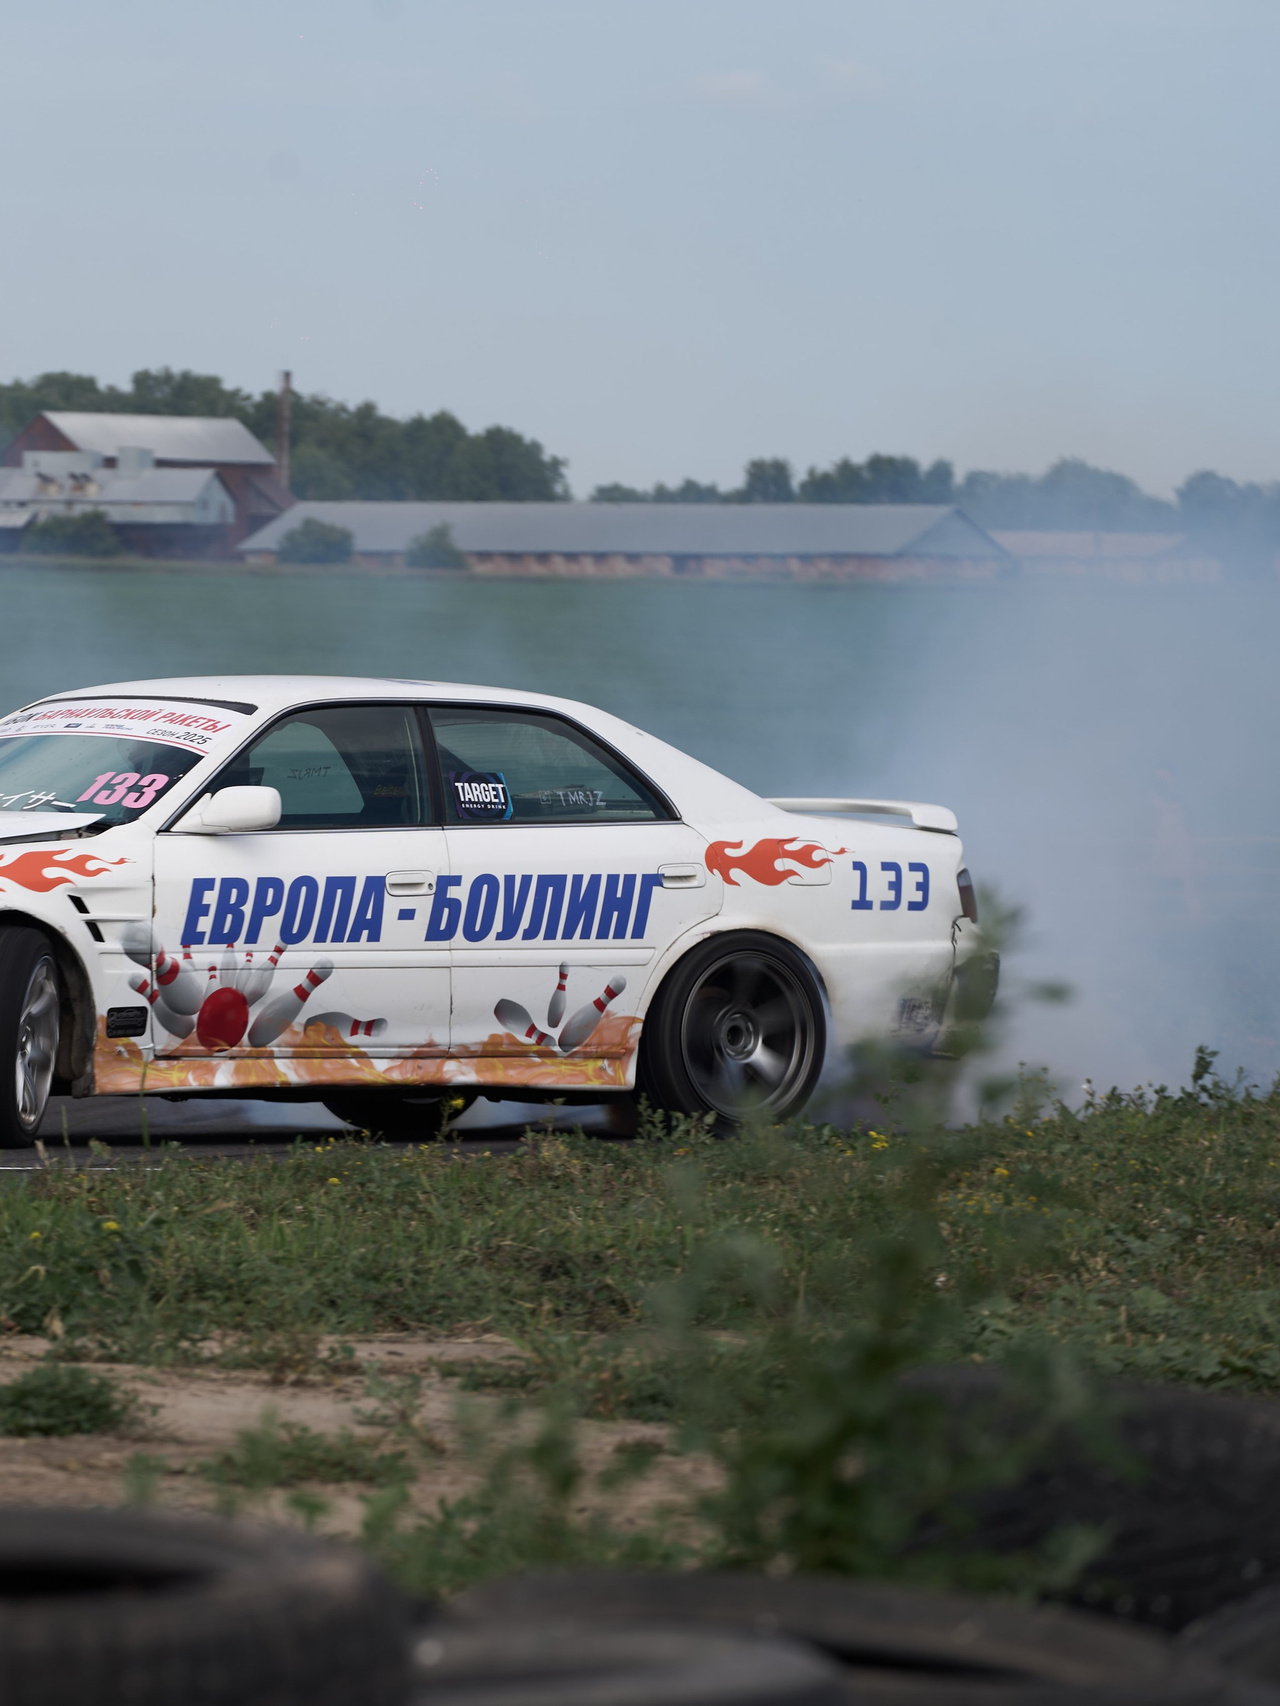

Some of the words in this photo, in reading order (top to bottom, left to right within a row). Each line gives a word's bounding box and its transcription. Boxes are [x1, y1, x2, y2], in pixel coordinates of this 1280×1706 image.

[146, 728, 179, 738] СЕЗОН
[175, 731, 213, 745] 2025
[160, 712, 232, 733] РАКЕТЫ
[76, 771, 170, 809] 133
[454, 782, 507, 803] TARGET
[851, 861, 930, 911] 133
[180, 875, 386, 945] ЕВРОПА
[424, 873, 665, 942] БОУЛИНГ
